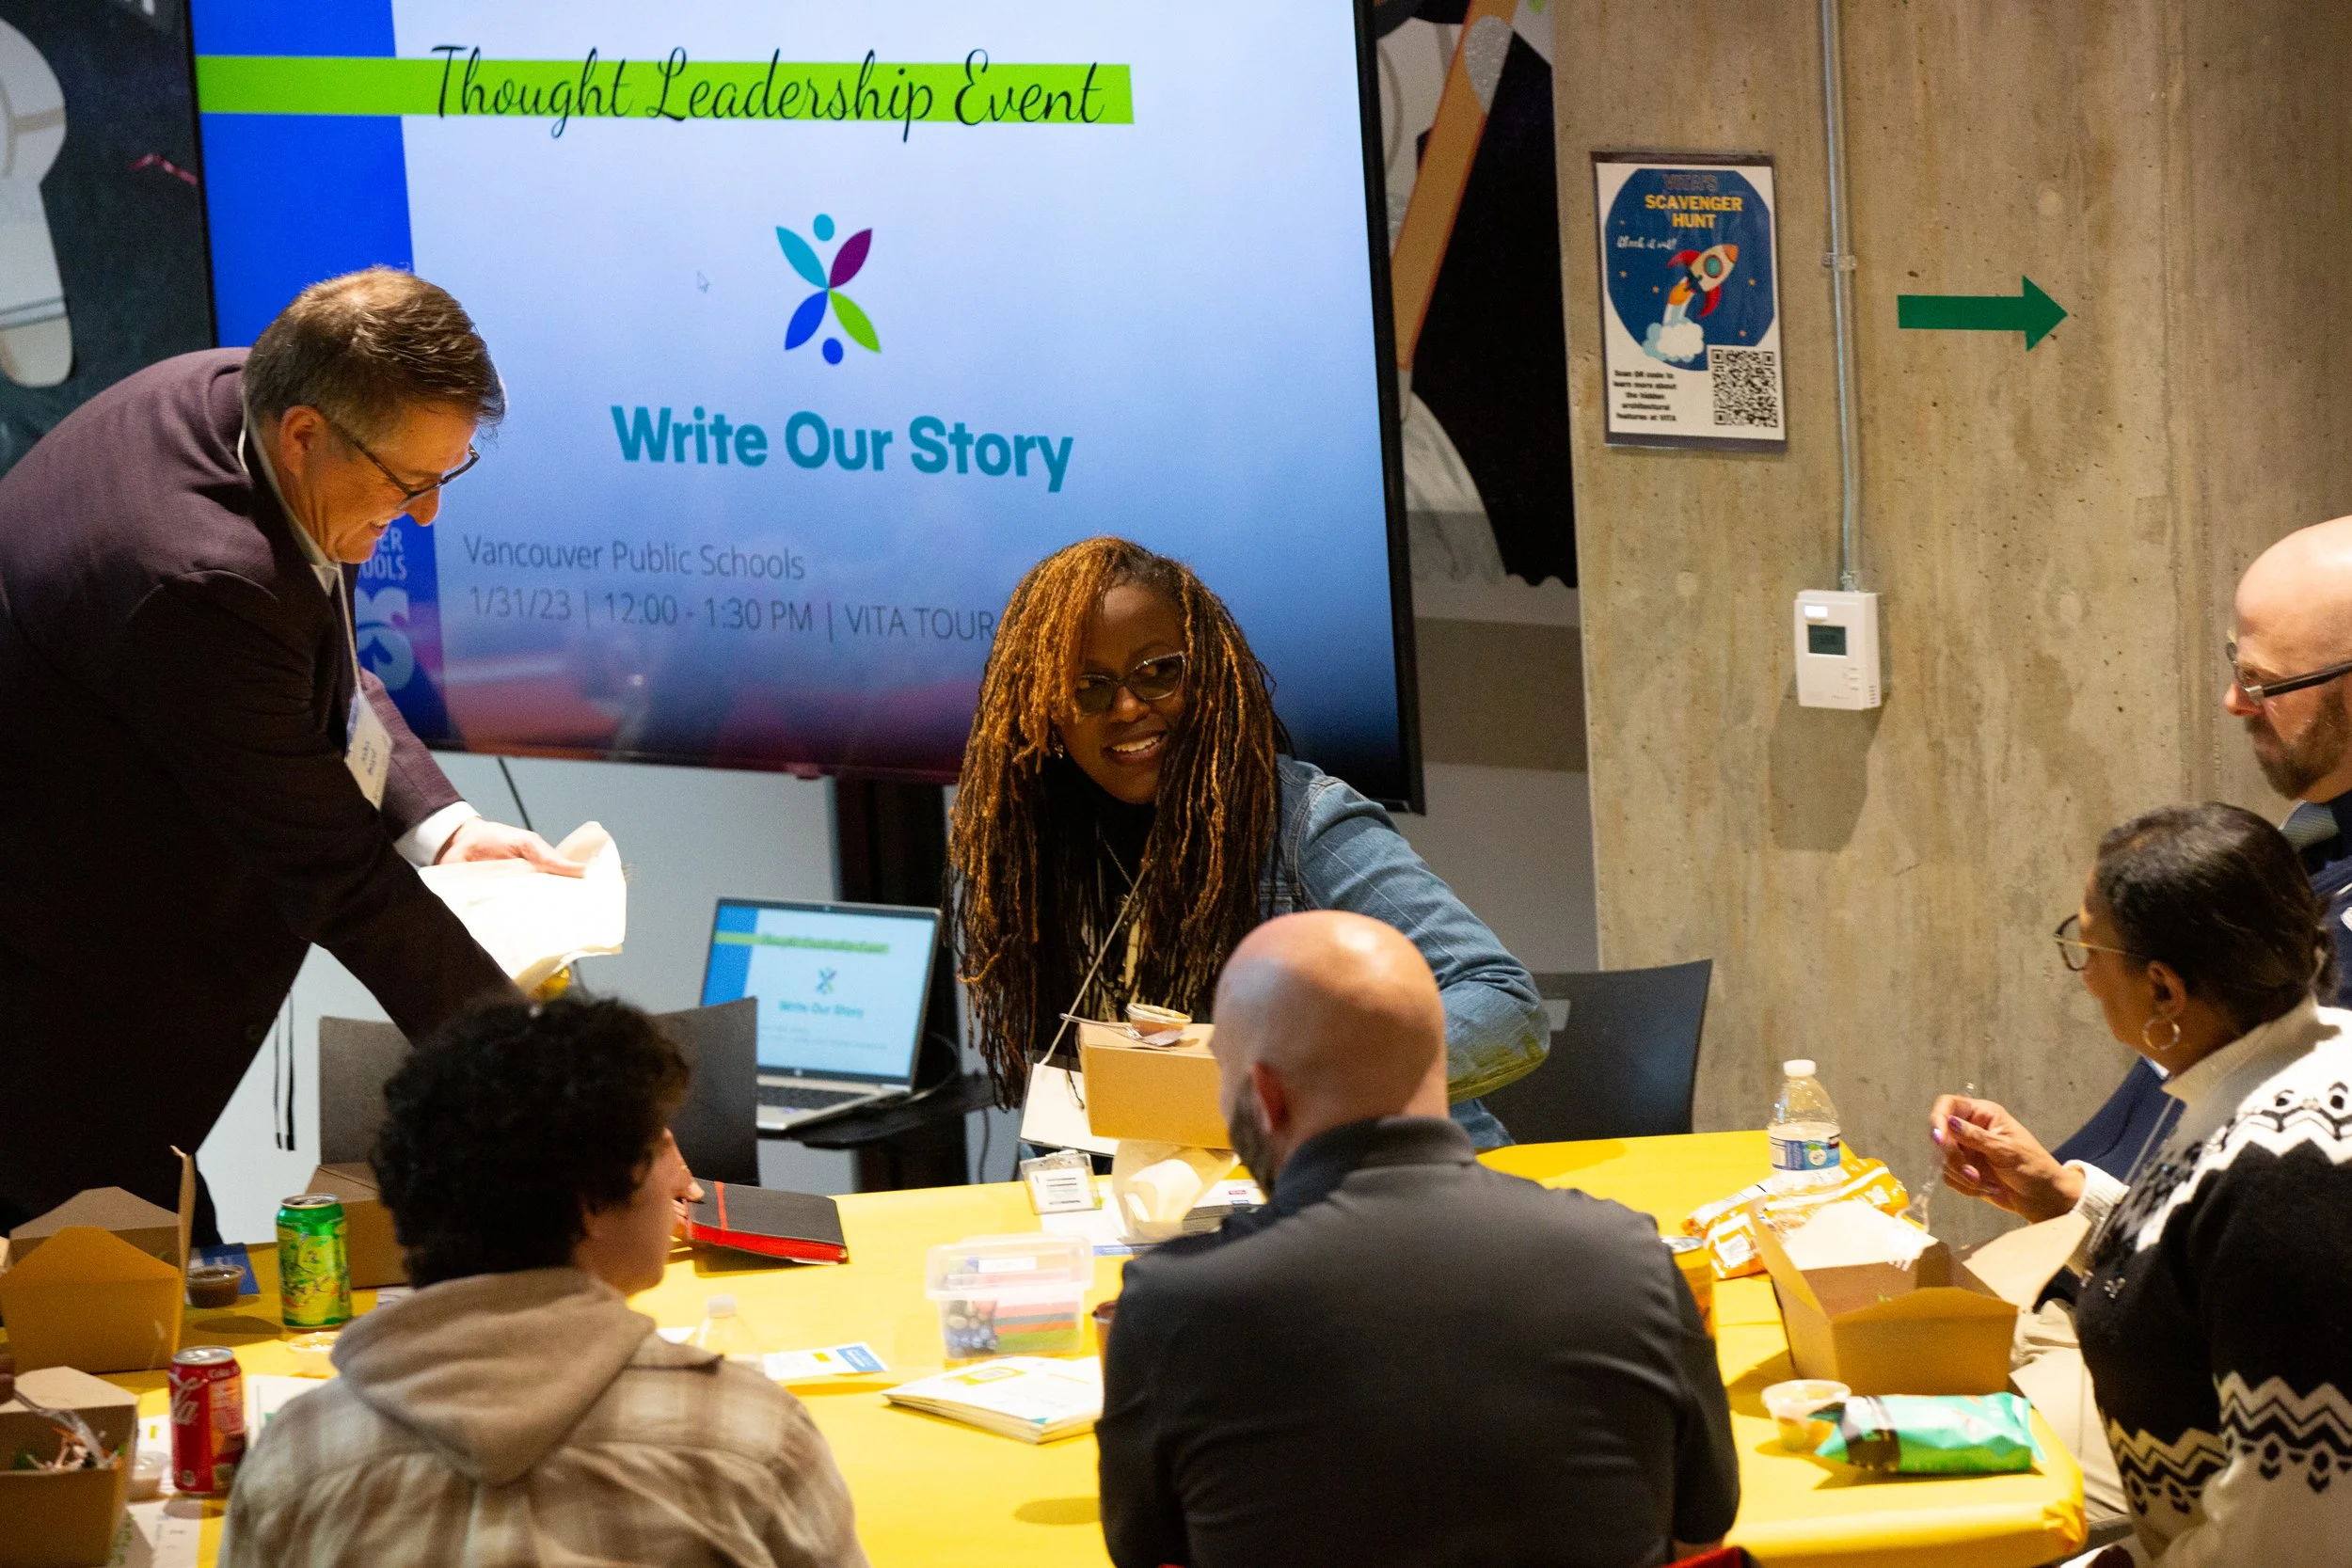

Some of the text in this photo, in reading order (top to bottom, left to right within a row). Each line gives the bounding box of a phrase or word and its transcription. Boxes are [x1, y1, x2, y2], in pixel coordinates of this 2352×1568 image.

[431, 44, 1106, 143] Thought Leadership Event
[1645, 195, 1742, 212] SCAVENGER
[1672, 213, 1717, 229] HUNT
[611, 404, 1074, 493] Write Our Story
[462, 534, 806, 581] Vancouver Public Schools
[469, 585, 572, 621] 1/31/23
[604, 593, 678, 628] 12:00
[705, 596, 762, 631] 1:30
[770, 599, 813, 632] PM
[847, 604, 908, 637] VITA
[913, 607, 996, 641] TOUR
